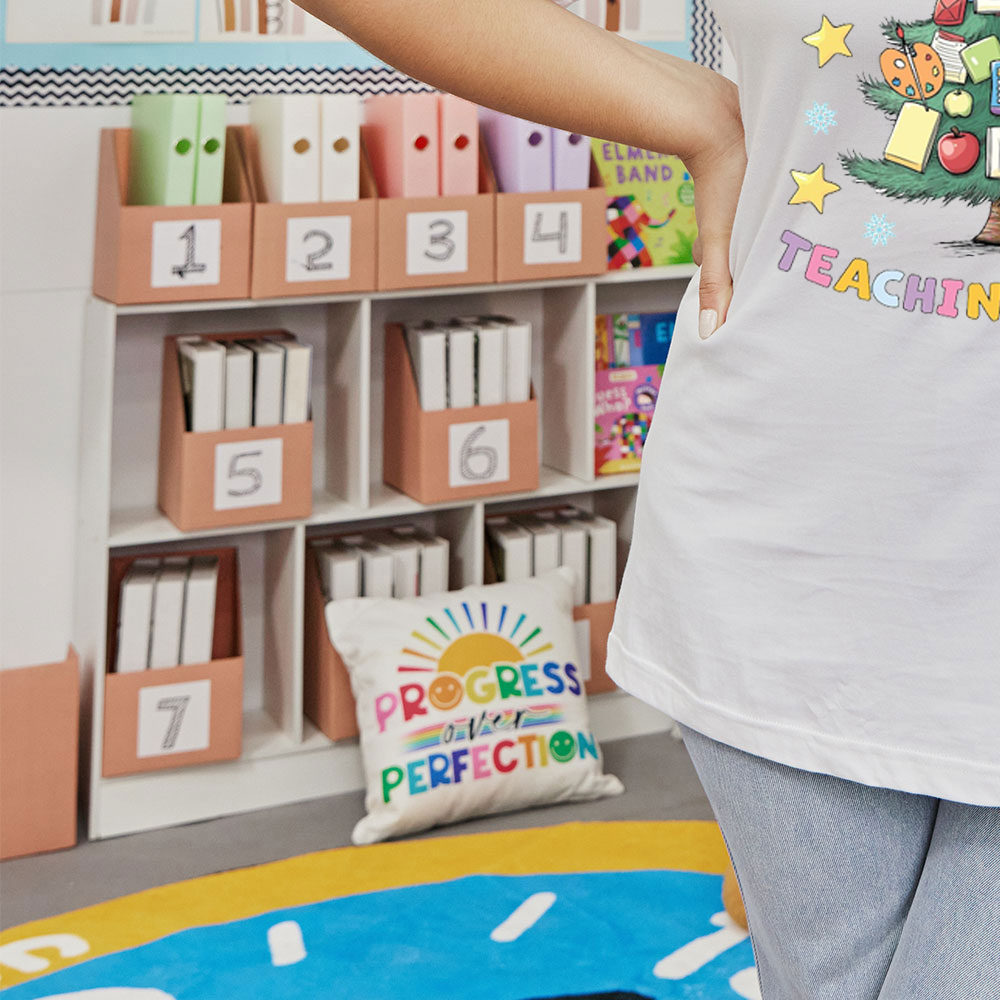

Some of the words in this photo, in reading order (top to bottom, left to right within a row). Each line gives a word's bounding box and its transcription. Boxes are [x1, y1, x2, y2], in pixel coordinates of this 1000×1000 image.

[616, 164, 673, 184] BAND
[171, 224, 206, 278] 1
[302, 230, 334, 271] 2
[424, 219, 456, 262] 3
[531, 211, 569, 255] 4
[227, 450, 265, 496] 5
[460, 425, 499, 481] 6
[374, 661, 583, 734] PROGRESS
[157, 695, 191, 750] 7
[441, 706, 531, 744] over
[381, 730, 599, 804] PERFECTION
